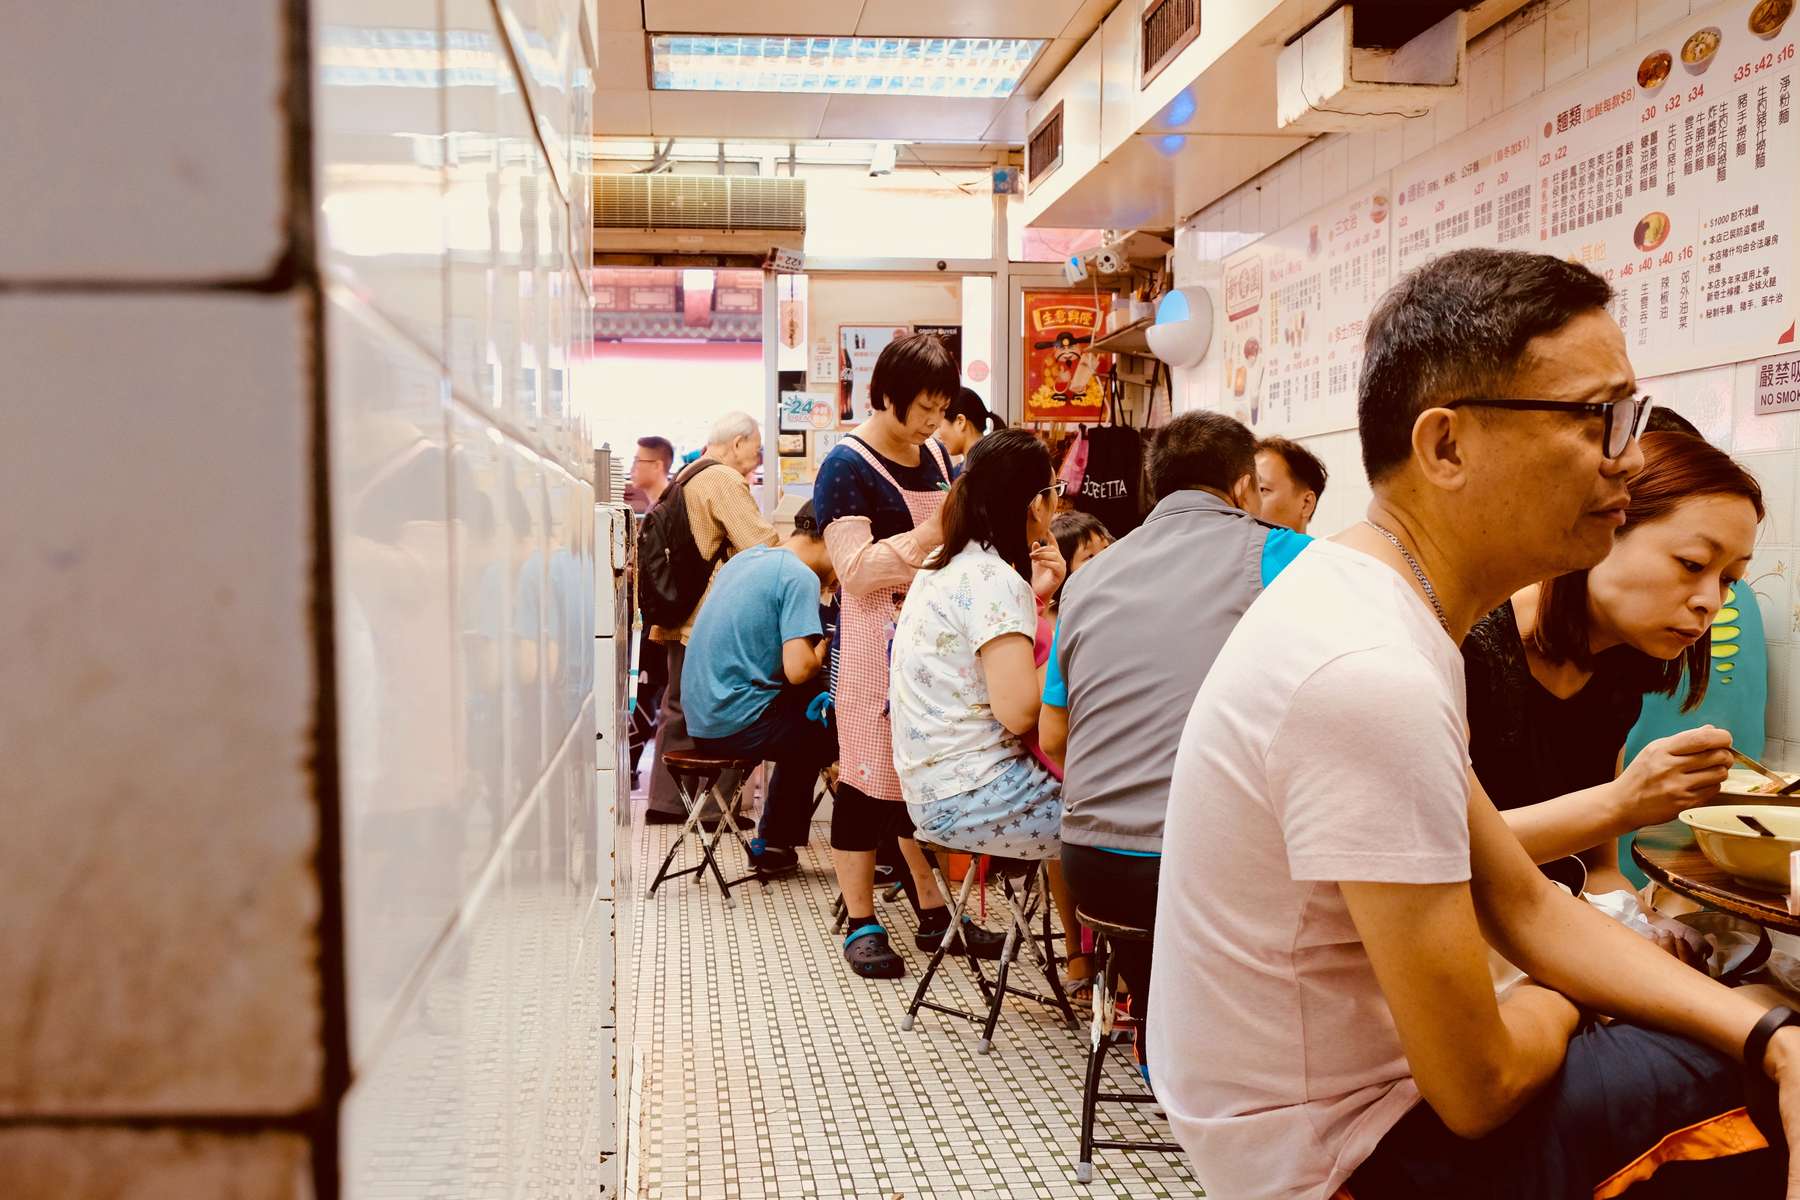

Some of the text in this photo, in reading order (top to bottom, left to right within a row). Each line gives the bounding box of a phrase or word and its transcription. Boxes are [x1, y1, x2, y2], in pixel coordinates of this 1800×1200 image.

[1776, 43, 1795, 64] $16
[1754, 53, 1774, 74] $42
[1734, 64, 1751, 82] $35
[1688, 84, 1704, 102] $34
[1664, 94, 1681, 112] $32
[1556, 103, 1582, 134] 麵類
[1641, 106, 1656, 123] $30
[1659, 251, 1673, 267] $40
[1678, 245, 1693, 262] $16
[1639, 257, 1652, 272] $40
[1042, 309, 1093, 326] 生意興隆
[1760, 394, 1774, 406] NO
